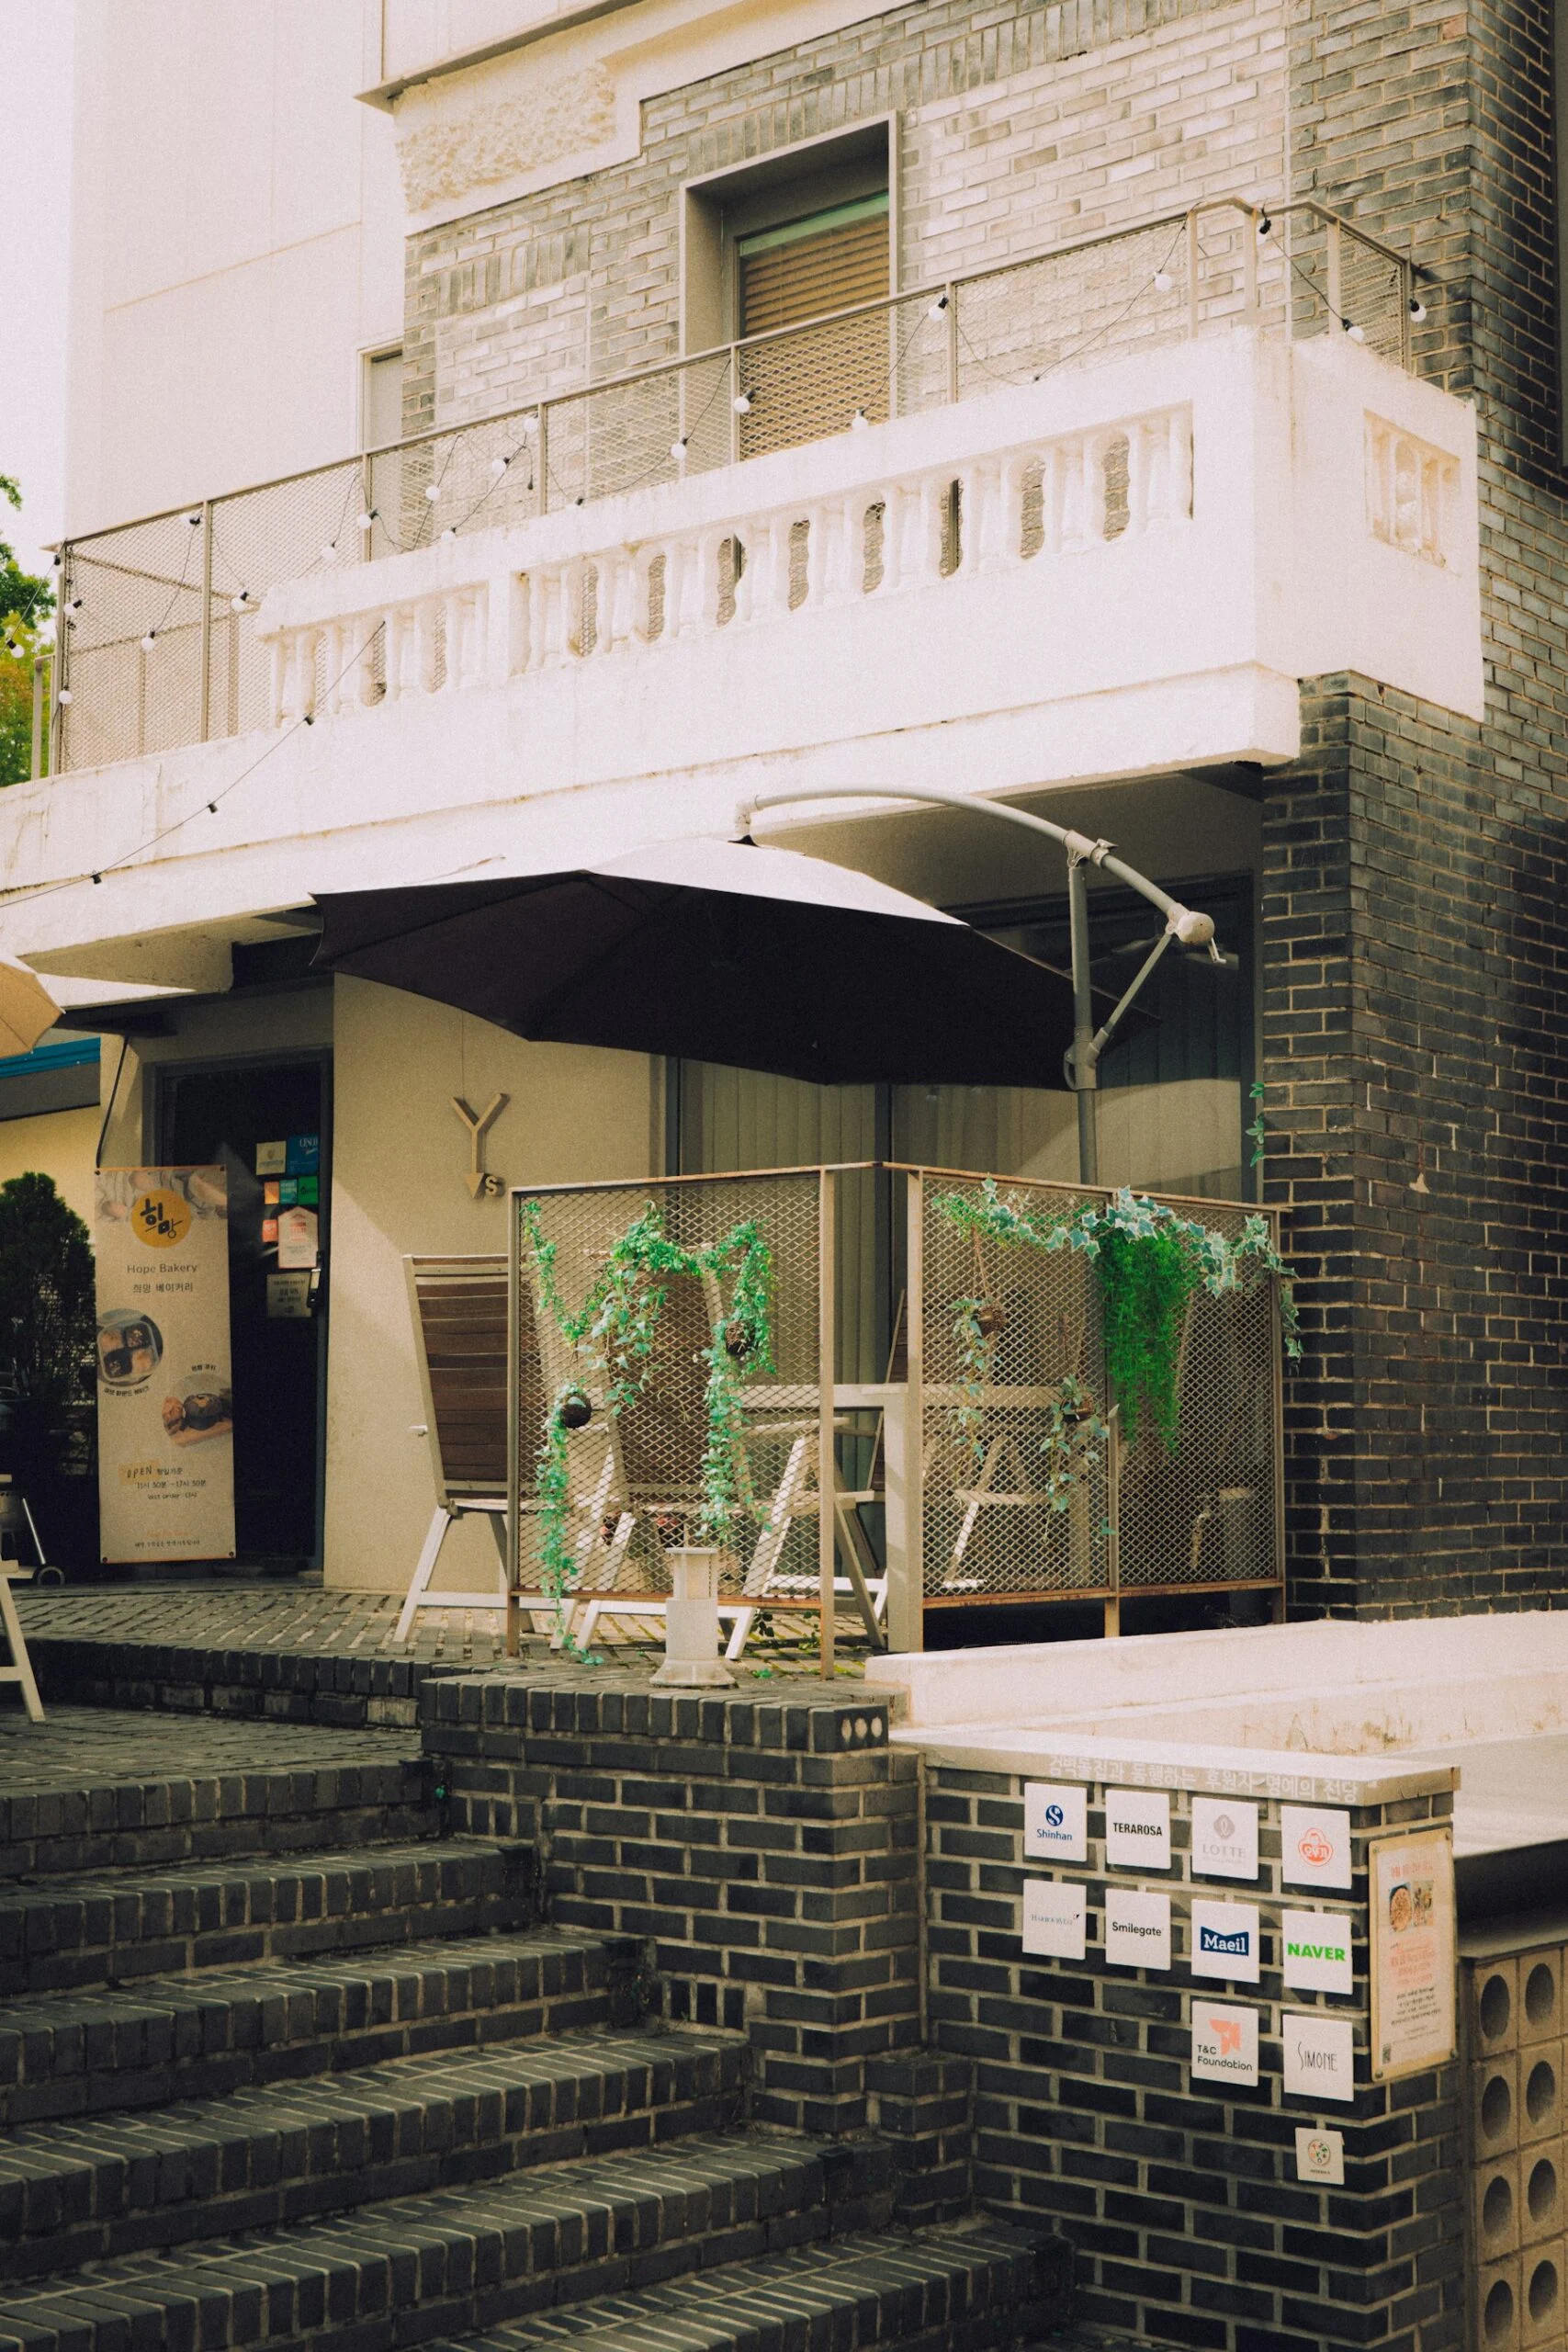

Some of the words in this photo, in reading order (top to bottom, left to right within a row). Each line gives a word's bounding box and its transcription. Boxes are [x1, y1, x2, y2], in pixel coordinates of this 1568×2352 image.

[140, 1197, 184, 1238] 희망
[127, 1264, 156, 1274] Hope
[159, 1263, 197, 1273] Bakery
[133, 1283, 151, 1294] 희망
[156, 1282, 193, 1294] 베이커리
[127, 1465, 152, 1479] OPEN
[1131, 1762, 1197, 1792] 동행하는
[1205, 1769, 1253, 1794] 후원자
[1266, 1773, 1315, 1800] 명예의
[1323, 1779, 1358, 1804] 전당
[1036, 1828, 1073, 1841] Shinhan
[1113, 1822, 1163, 1837] TERAROSA
[1202, 1843, 1247, 1858] LOTTE
[1111, 1921, 1162, 1937] Smilegate
[1203, 1934, 1247, 1953] Maeil
[1287, 1942, 1346, 1962] NAVER
[1197, 2044, 1217, 2055] T&C
[1297, 2041, 1338, 2072] SIMONE
[1197, 2055, 1252, 2072] Foundation
